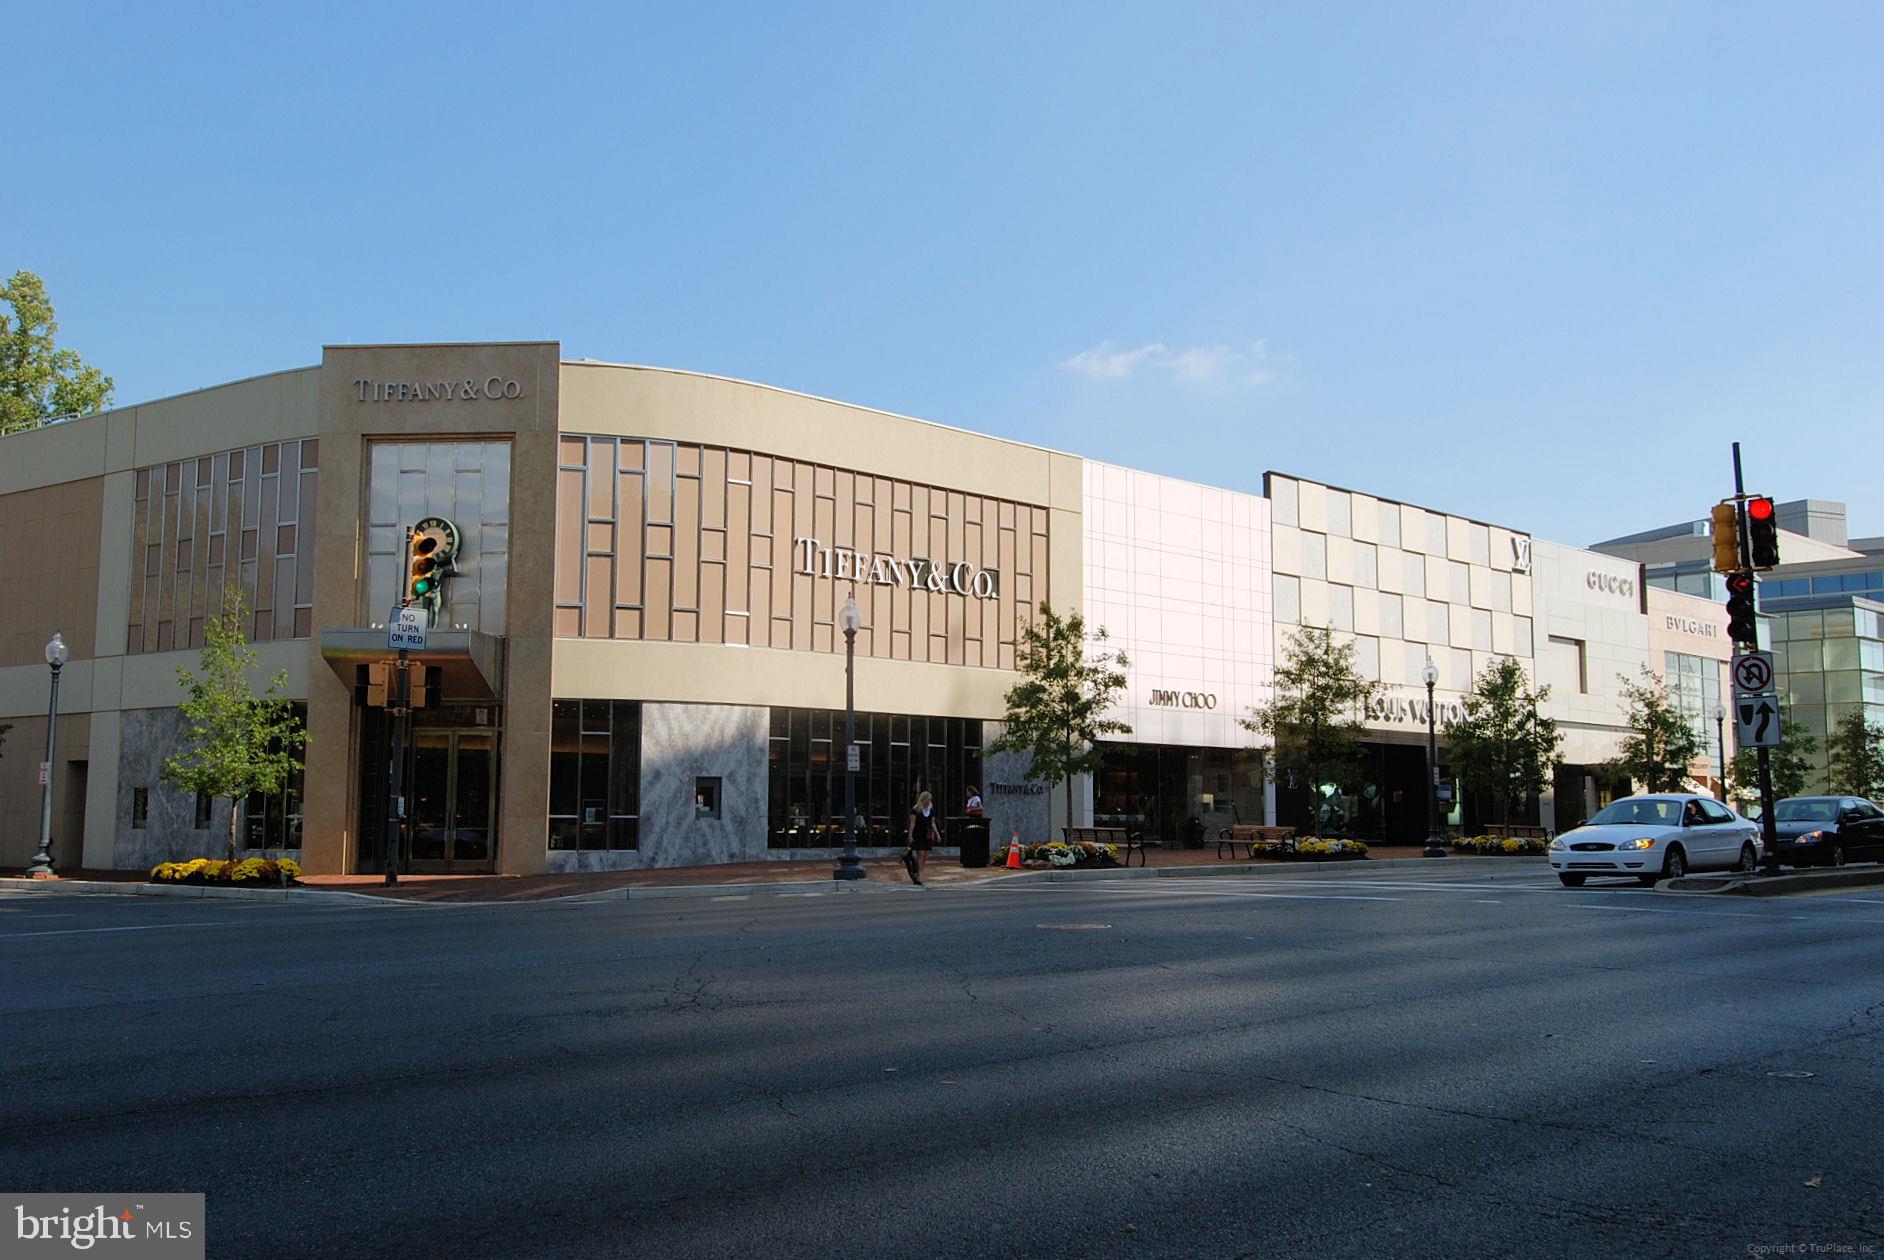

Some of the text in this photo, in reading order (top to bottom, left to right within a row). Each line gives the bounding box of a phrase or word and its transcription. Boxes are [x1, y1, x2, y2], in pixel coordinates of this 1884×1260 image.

[1586, 570, 1634, 599] GUCCI
[401, 613, 415, 623] NO
[397, 623, 420, 633] TURN
[1666, 615, 1717, 638] BVLGARI
[391, 633, 423, 645] ON RED
[1149, 689, 1217, 709] JIMMY CHOO
